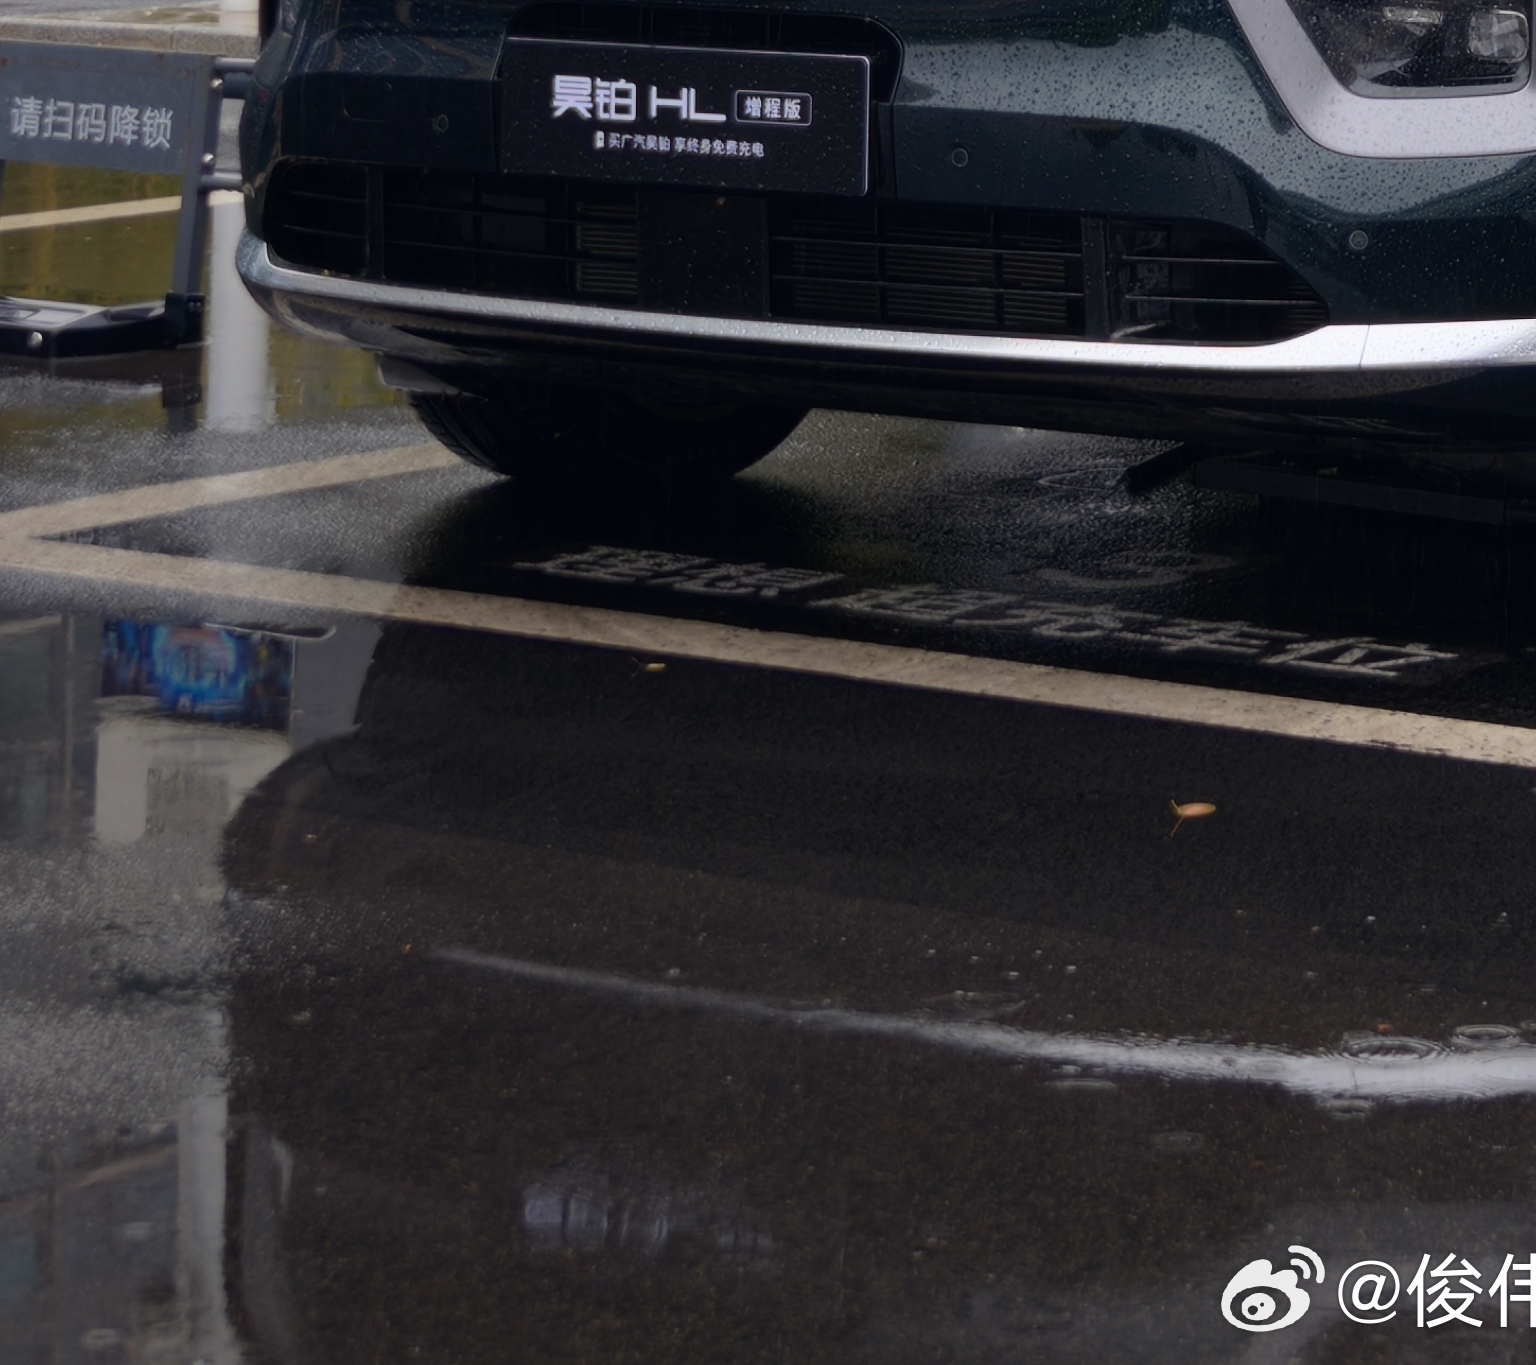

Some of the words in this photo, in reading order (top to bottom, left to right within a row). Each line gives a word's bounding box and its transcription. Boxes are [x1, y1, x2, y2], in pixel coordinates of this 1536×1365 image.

[10, 95, 174, 150] 请扫码降锁
[551, 74, 637, 122] 昊铂
[649, 85, 727, 123] HL
[743, 95, 802, 121] 增程版
[674, 136, 765, 158] 享终身免费充电
[512, 545, 846, 597] 理想
[807, 582, 1459, 676] 超充车位
